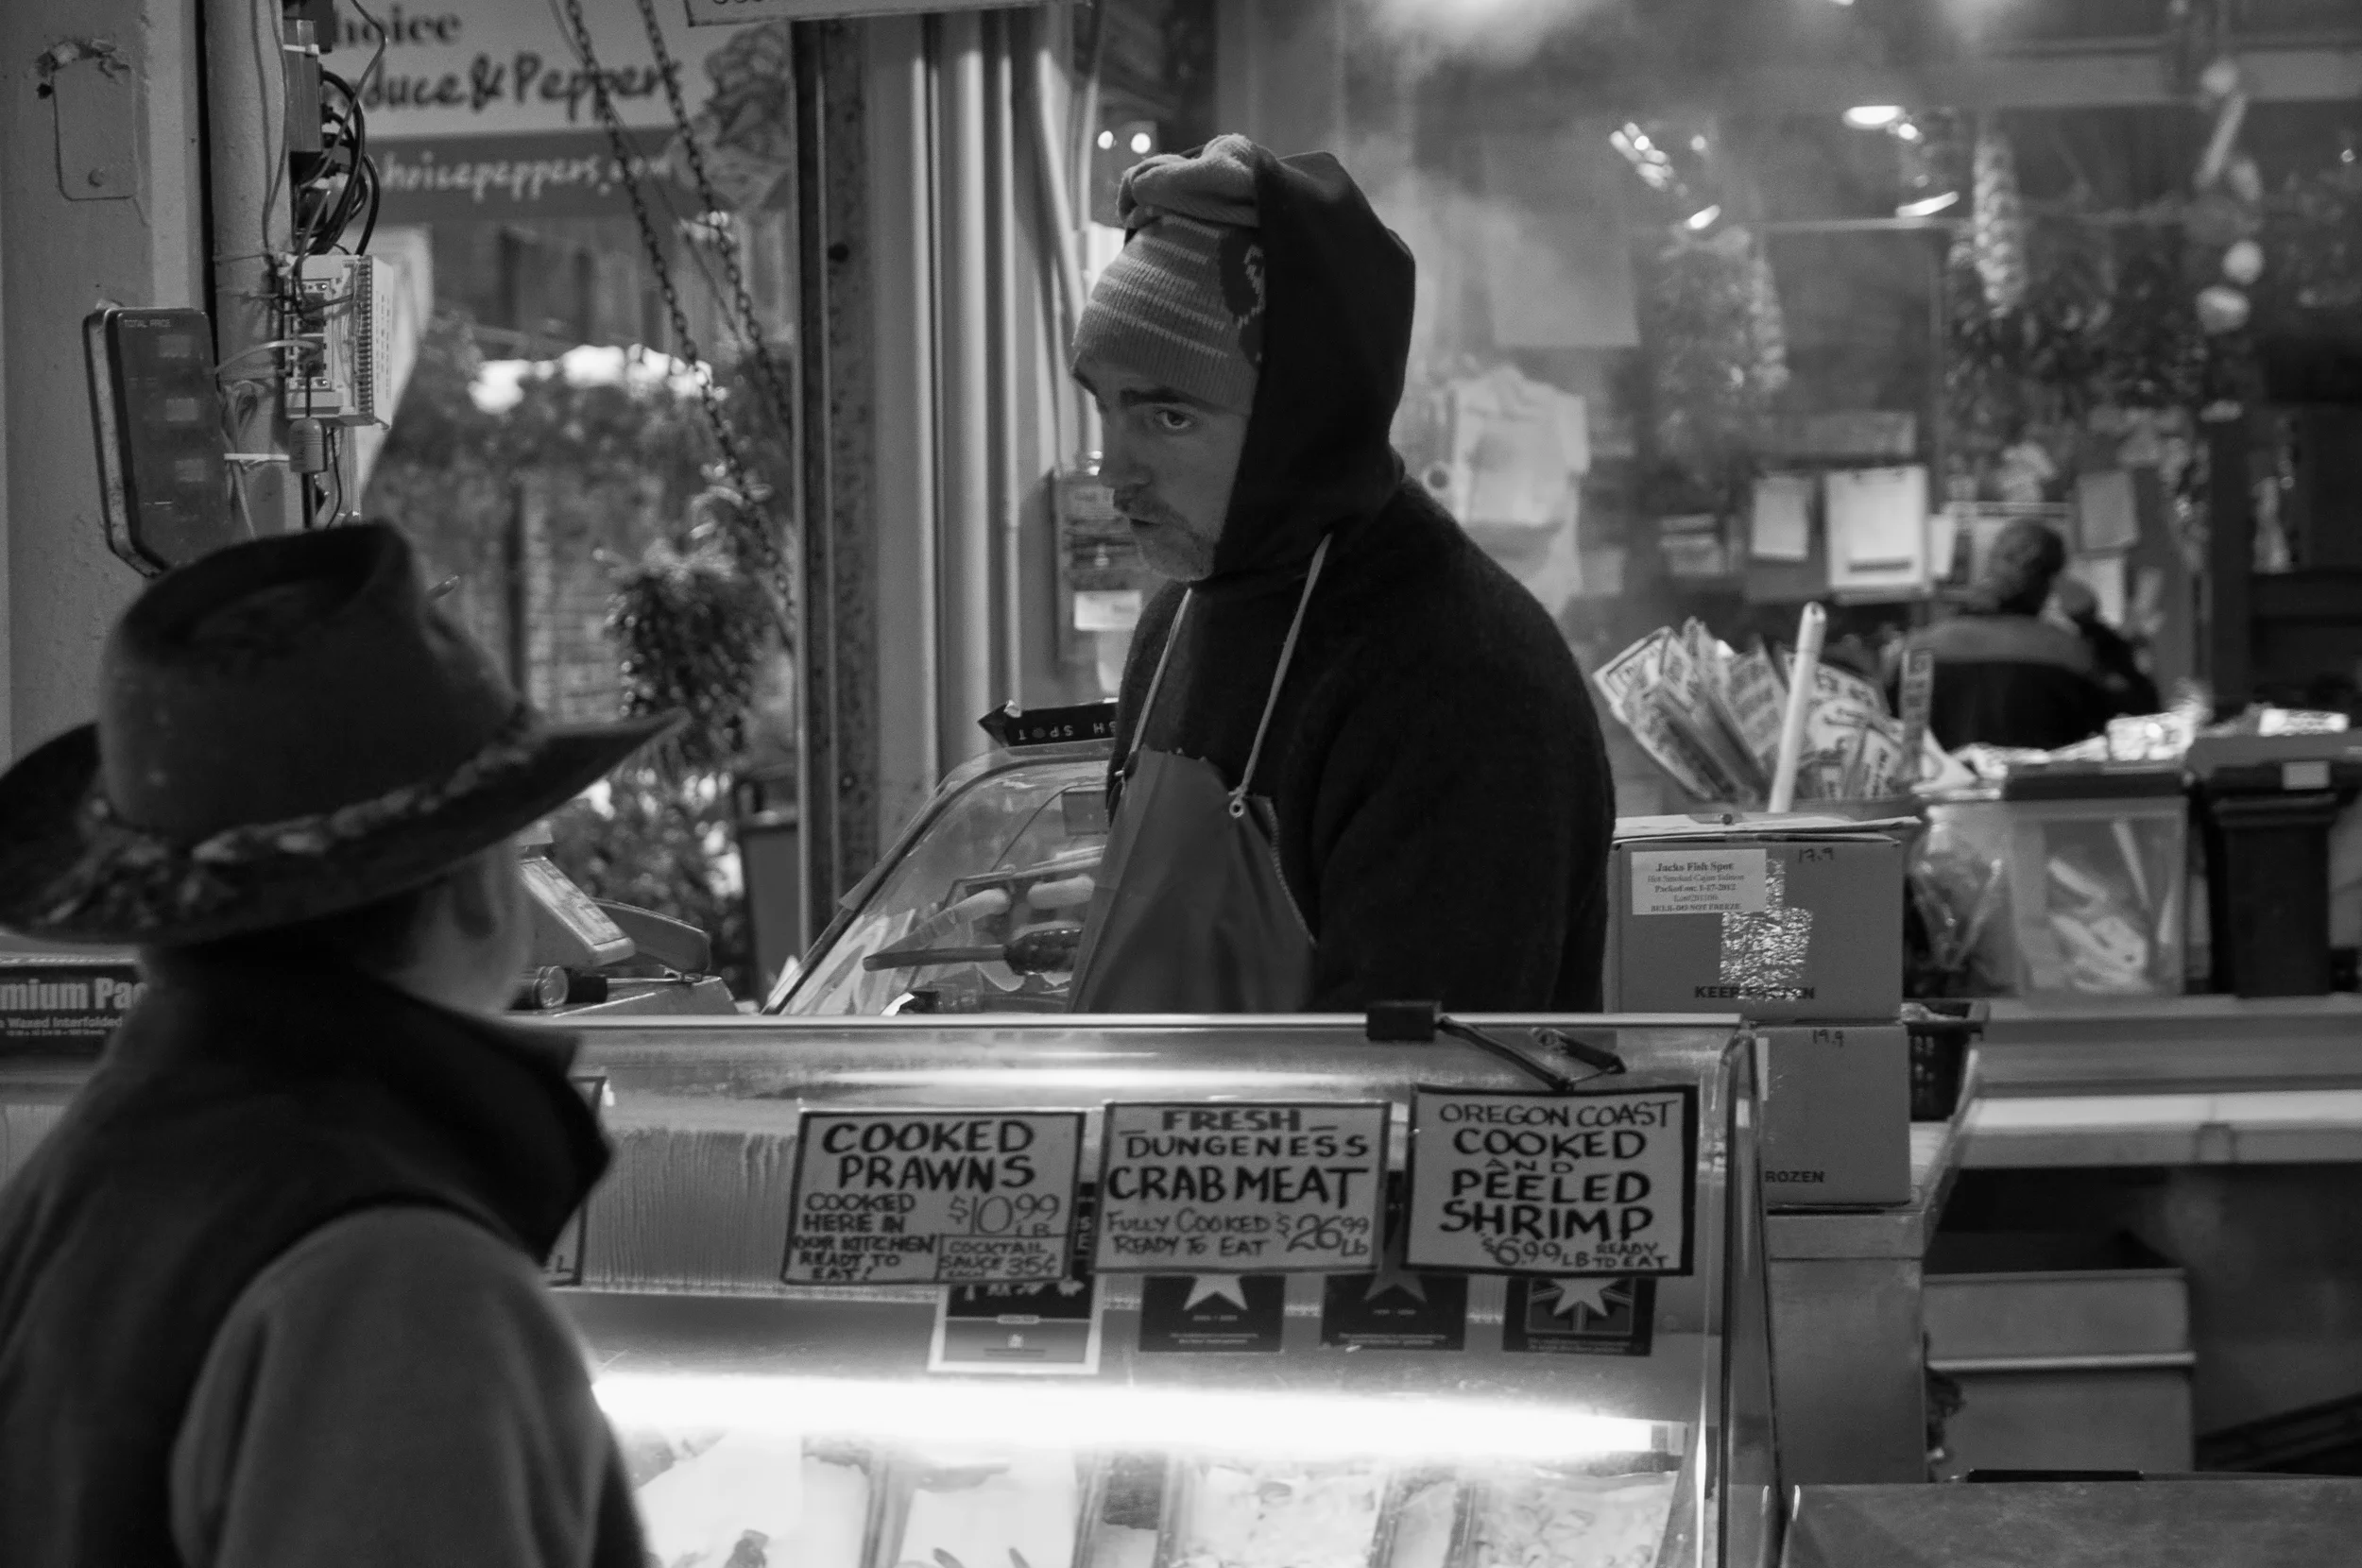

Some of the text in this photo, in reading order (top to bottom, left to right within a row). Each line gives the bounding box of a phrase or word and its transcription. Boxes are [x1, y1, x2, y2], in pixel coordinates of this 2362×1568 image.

[1686, 862, 1708, 871] Fish
[1695, 986, 1739, 998] KEEP
[1162, 1109, 1301, 1132] FRESH
[1439, 1099, 1678, 1129] OREGON COAST
[823, 1120, 1035, 1154] COOKED
[1126, 1135, 1367, 1158] DUNGENESS
[1452, 1128, 1647, 1159] COOKED
[839, 1154, 1036, 1193] PRAWNS
[1485, 1158, 1575, 1173] AND
[1451, 1167, 1652, 1204] PEELED
[805, 1193, 916, 1212] COOKED
[804, 1215, 871, 1233] HERE
[1107, 1210, 1170, 1232] FULLY
[1177, 1208, 1270, 1233] COOKED
[1439, 1199, 1653, 1241] SHRIMP
[1114, 1235, 1178, 1254] READY
[1220, 1236, 1270, 1256] EAT
[1563, 1251, 1591, 1268] LB
[1621, 1254, 1669, 1269] EAT
